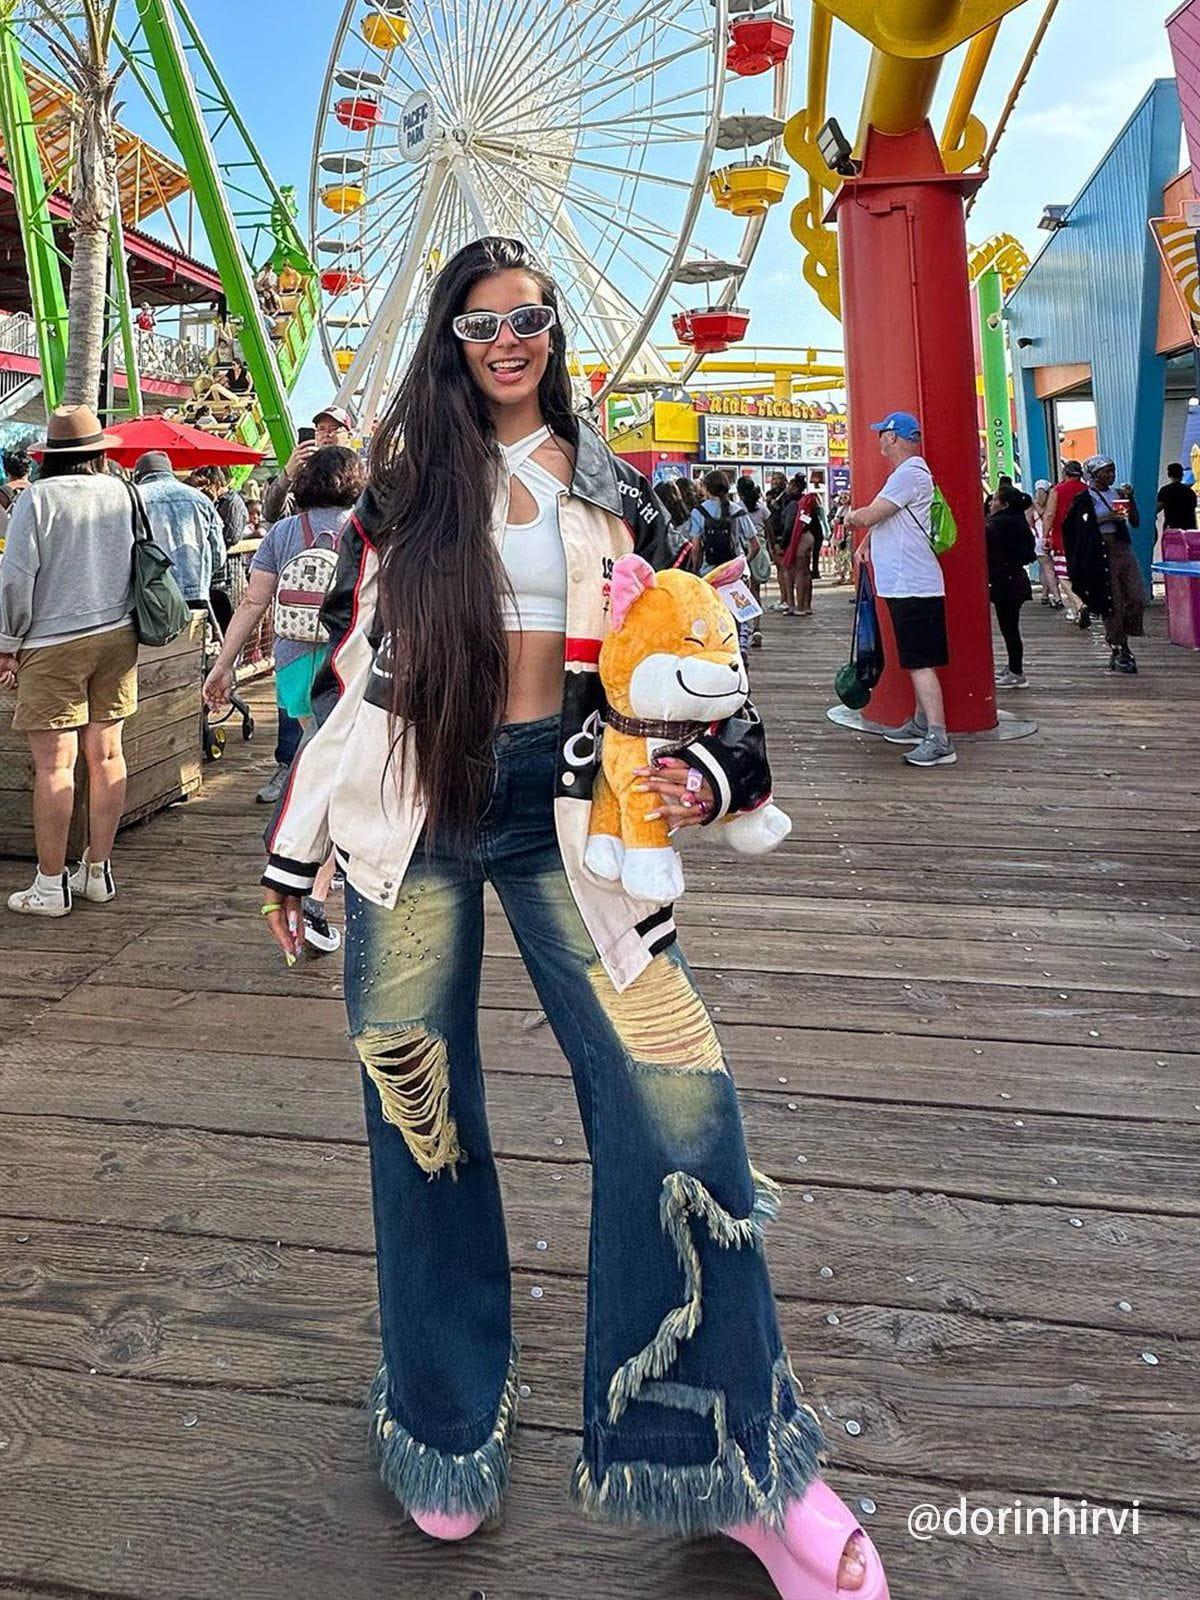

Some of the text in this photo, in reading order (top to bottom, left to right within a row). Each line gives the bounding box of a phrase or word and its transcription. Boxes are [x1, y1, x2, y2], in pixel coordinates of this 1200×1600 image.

[406, 124, 425, 148] PARK
[709, 395, 819, 419] RIDE TICKETS
[640, 502, 659, 524] it!
